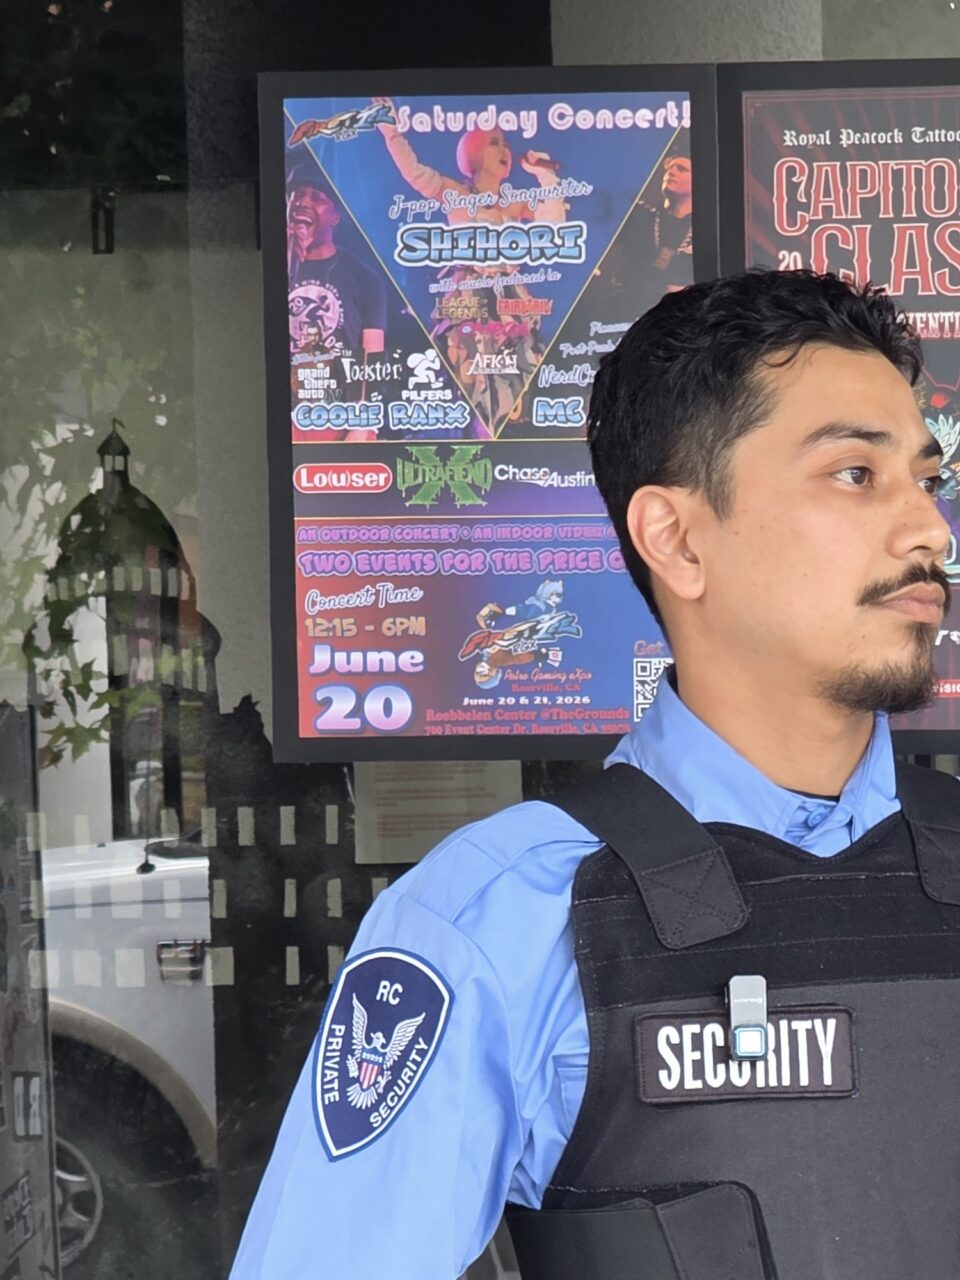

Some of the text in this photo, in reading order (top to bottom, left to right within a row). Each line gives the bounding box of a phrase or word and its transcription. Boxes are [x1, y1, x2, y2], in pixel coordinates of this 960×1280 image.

[397, 104, 537, 138] Saturday
[548, 101, 690, 130] Concert!
[783, 129, 831, 148] Royal
[839, 128, 904, 147] Peacock
[389, 179, 593, 222] J-pop Singer Songwriter
[396, 222, 585, 264] SHIHORI
[436, 298, 480, 308] LEAGUE
[436, 307, 488, 318] LEGENDS
[298, 367, 329, 380] grand
[304, 378, 337, 389] theft
[298, 389, 324, 398] auto
[402, 390, 453, 400] PILFERS
[294, 402, 470, 430] COOLIE RANX
[534, 397, 585, 426] MC
[300, 468, 389, 488] Lo(u)ser
[494, 464, 596, 488] Chase Austin
[297, 527, 318, 542] AN
[320, 526, 391, 541] OUTDOOR
[393, 525, 459, 541] CONCERT
[473, 526, 493, 540] AN
[496, 525, 553, 540] INDOOR
[299, 551, 352, 576] TWO
[354, 550, 438, 575] EVENTS
[440, 550, 488, 574] FOR
[490, 549, 534, 573] THE
[537, 549, 604, 573] PRICE
[305, 582, 424, 615] Concert Time
[305, 618, 357, 638] 12:15
[381, 617, 426, 637] 6PM
[634, 640, 664, 655] Get
[309, 645, 425, 675] June
[313, 683, 413, 734] 20
[462, 696, 590, 707] June 20 & 21, 2026
[495, 708, 537, 721] Center
[444, 725, 473, 735] Event
[376, 980, 403, 1005] RC
[323, 1024, 346, 1105] PRIVATE
[369, 1037, 429, 1128] SECURITY
